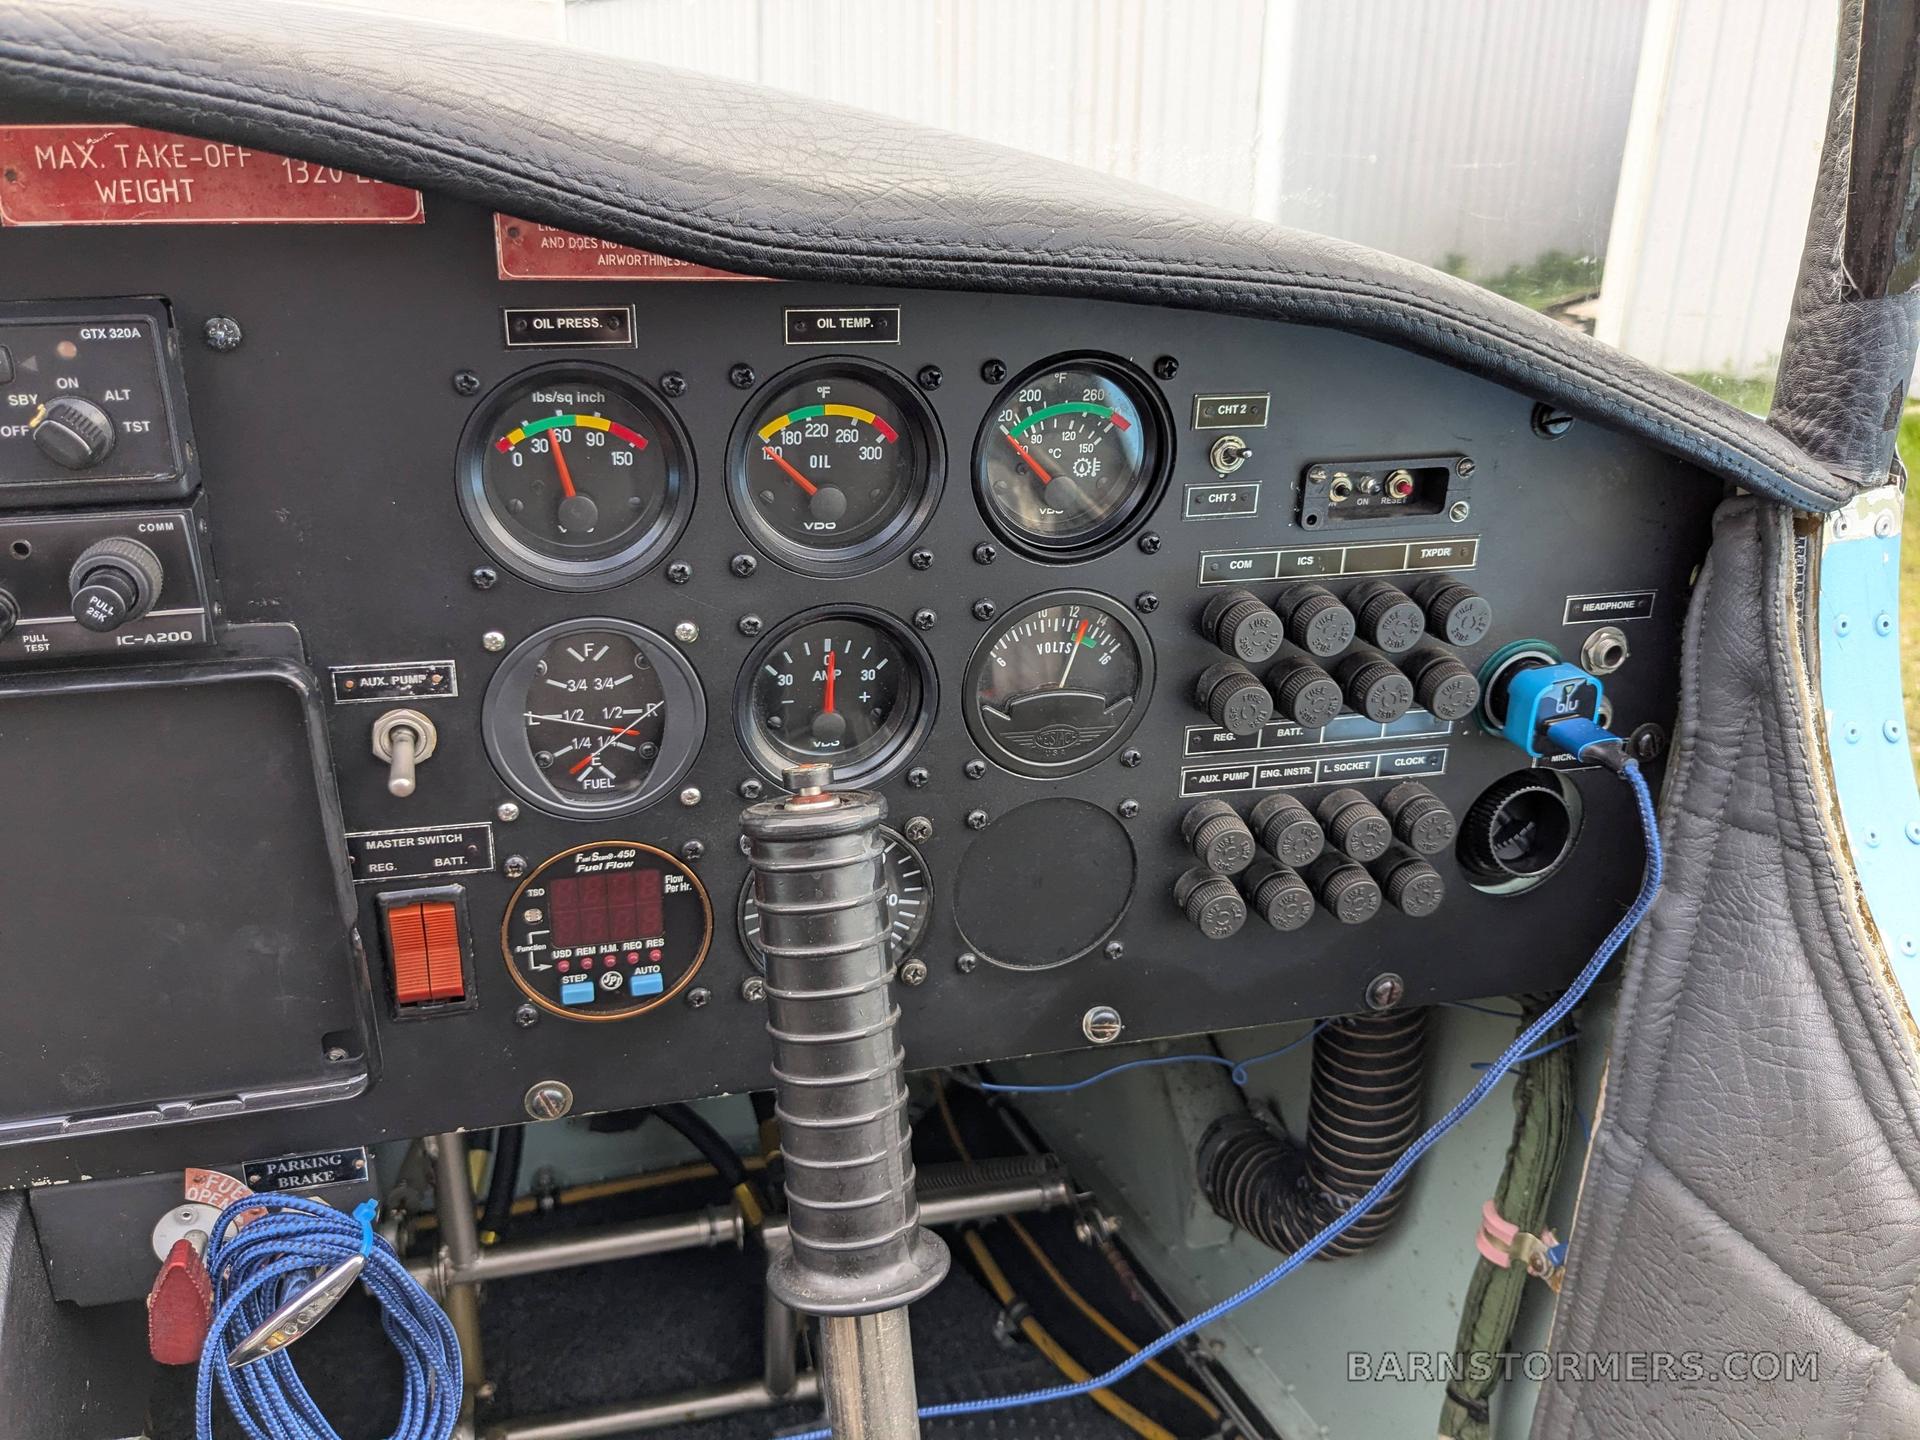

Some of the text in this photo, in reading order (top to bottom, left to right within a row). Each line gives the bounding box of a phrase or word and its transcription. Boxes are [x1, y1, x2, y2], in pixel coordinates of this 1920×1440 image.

[35, 144, 252, 170] MAX. TAKE-OFF
[95, 178, 194, 205] WEIGHT
[541, 238, 623, 250] AND DOES NO
[533, 317, 603, 331] OIL PRESS.
[816, 317, 874, 329] OIL TEMP.
[80, 327, 142, 340] GTX 320A
[56, 377, 79, 389] ON
[8, 394, 39, 406] SBY
[104, 389, 131, 402] ALT
[577, 391, 606, 403] inch
[1019, 389, 1042, 402] 200
[1083, 389, 1105, 401] 260
[1218, 404, 1247, 415] CHT 2
[1, 425, 30, 437] OFF
[123, 421, 151, 433] TST
[805, 423, 829, 438] 220
[553, 428, 572, 443] 60
[585, 432, 605, 447] 90
[781, 431, 802, 445] 180
[835, 429, 859, 443] 260
[1030, 434, 1043, 444] 90
[1062, 432, 1077, 441] 120
[530, 438, 549, 454] 30
[1079, 443, 1095, 454] 150
[611, 451, 633, 466] 150
[859, 446, 882, 460] 300
[512, 452, 523, 467] 0
[809, 455, 831, 469] OIL
[1208, 493, 1237, 503] CHT 3
[1356, 497, 1369, 506] ON
[138, 522, 174, 532] COMM
[804, 521, 837, 530] VDO
[1420, 547, 1452, 559] TXPDR
[1229, 559, 1253, 570] COM
[1297, 556, 1315, 566] ICS
[90, 595, 115, 616] PULL
[1582, 600, 1636, 612] HEADPHONE
[85, 608, 108, 623] 25K
[1069, 606, 1080, 618] 12
[1096, 614, 1108, 627] 14
[23, 634, 49, 643] PULL
[116, 631, 193, 646] IC-A200
[24, 643, 50, 653] TEST
[584, 643, 595, 657] F
[1036, 642, 1073, 656] VOLTS
[996, 656, 1008, 668] 6
[1098, 653, 1111, 666] 16
[360, 674, 427, 687] AUX. PUMP
[777, 674, 793, 686] 30
[860, 669, 876, 681] 30
[567, 679, 588, 692] 3/4
[593, 677, 615, 690] 3/4
[646, 703, 659, 717] R
[1555, 698, 1579, 714] blu
[529, 711, 541, 726] L
[564, 708, 585, 722] 1/2
[602, 706, 623, 720] 1/2
[1213, 732, 1236, 742] REG.
[1276, 727, 1304, 738] BATT.
[572, 737, 592, 750] 1/4
[1323, 761, 1370, 773] L. SOCKET
[1394, 756, 1425, 767] CLOCK
[1198, 771, 1250, 783] AUX. PUMP
[1260, 766, 1313, 779] ENG. INSTR.
[583, 778, 615, 790] FUEL
[366, 834, 463, 850] MASTER SWITCH
[368, 862, 398, 873] REG.
[434, 856, 468, 867] BATT.
[576, 861, 635, 873] Fuel Flow
[665, 875, 684, 884] Flow
[664, 882, 692, 894] Per Hr.
[516, 943, 547, 953] Function
[600, 943, 619, 953] H.M.
[623, 941, 643, 951] REQ
[646, 938, 665, 948] RES
[552, 949, 572, 959] USD
[575, 946, 596, 957] REM
[634, 965, 661, 975] AUTO
[562, 974, 588, 984] STEP
[267, 1154, 342, 1175] PARKING
[279, 1170, 335, 1189] BRAKE
